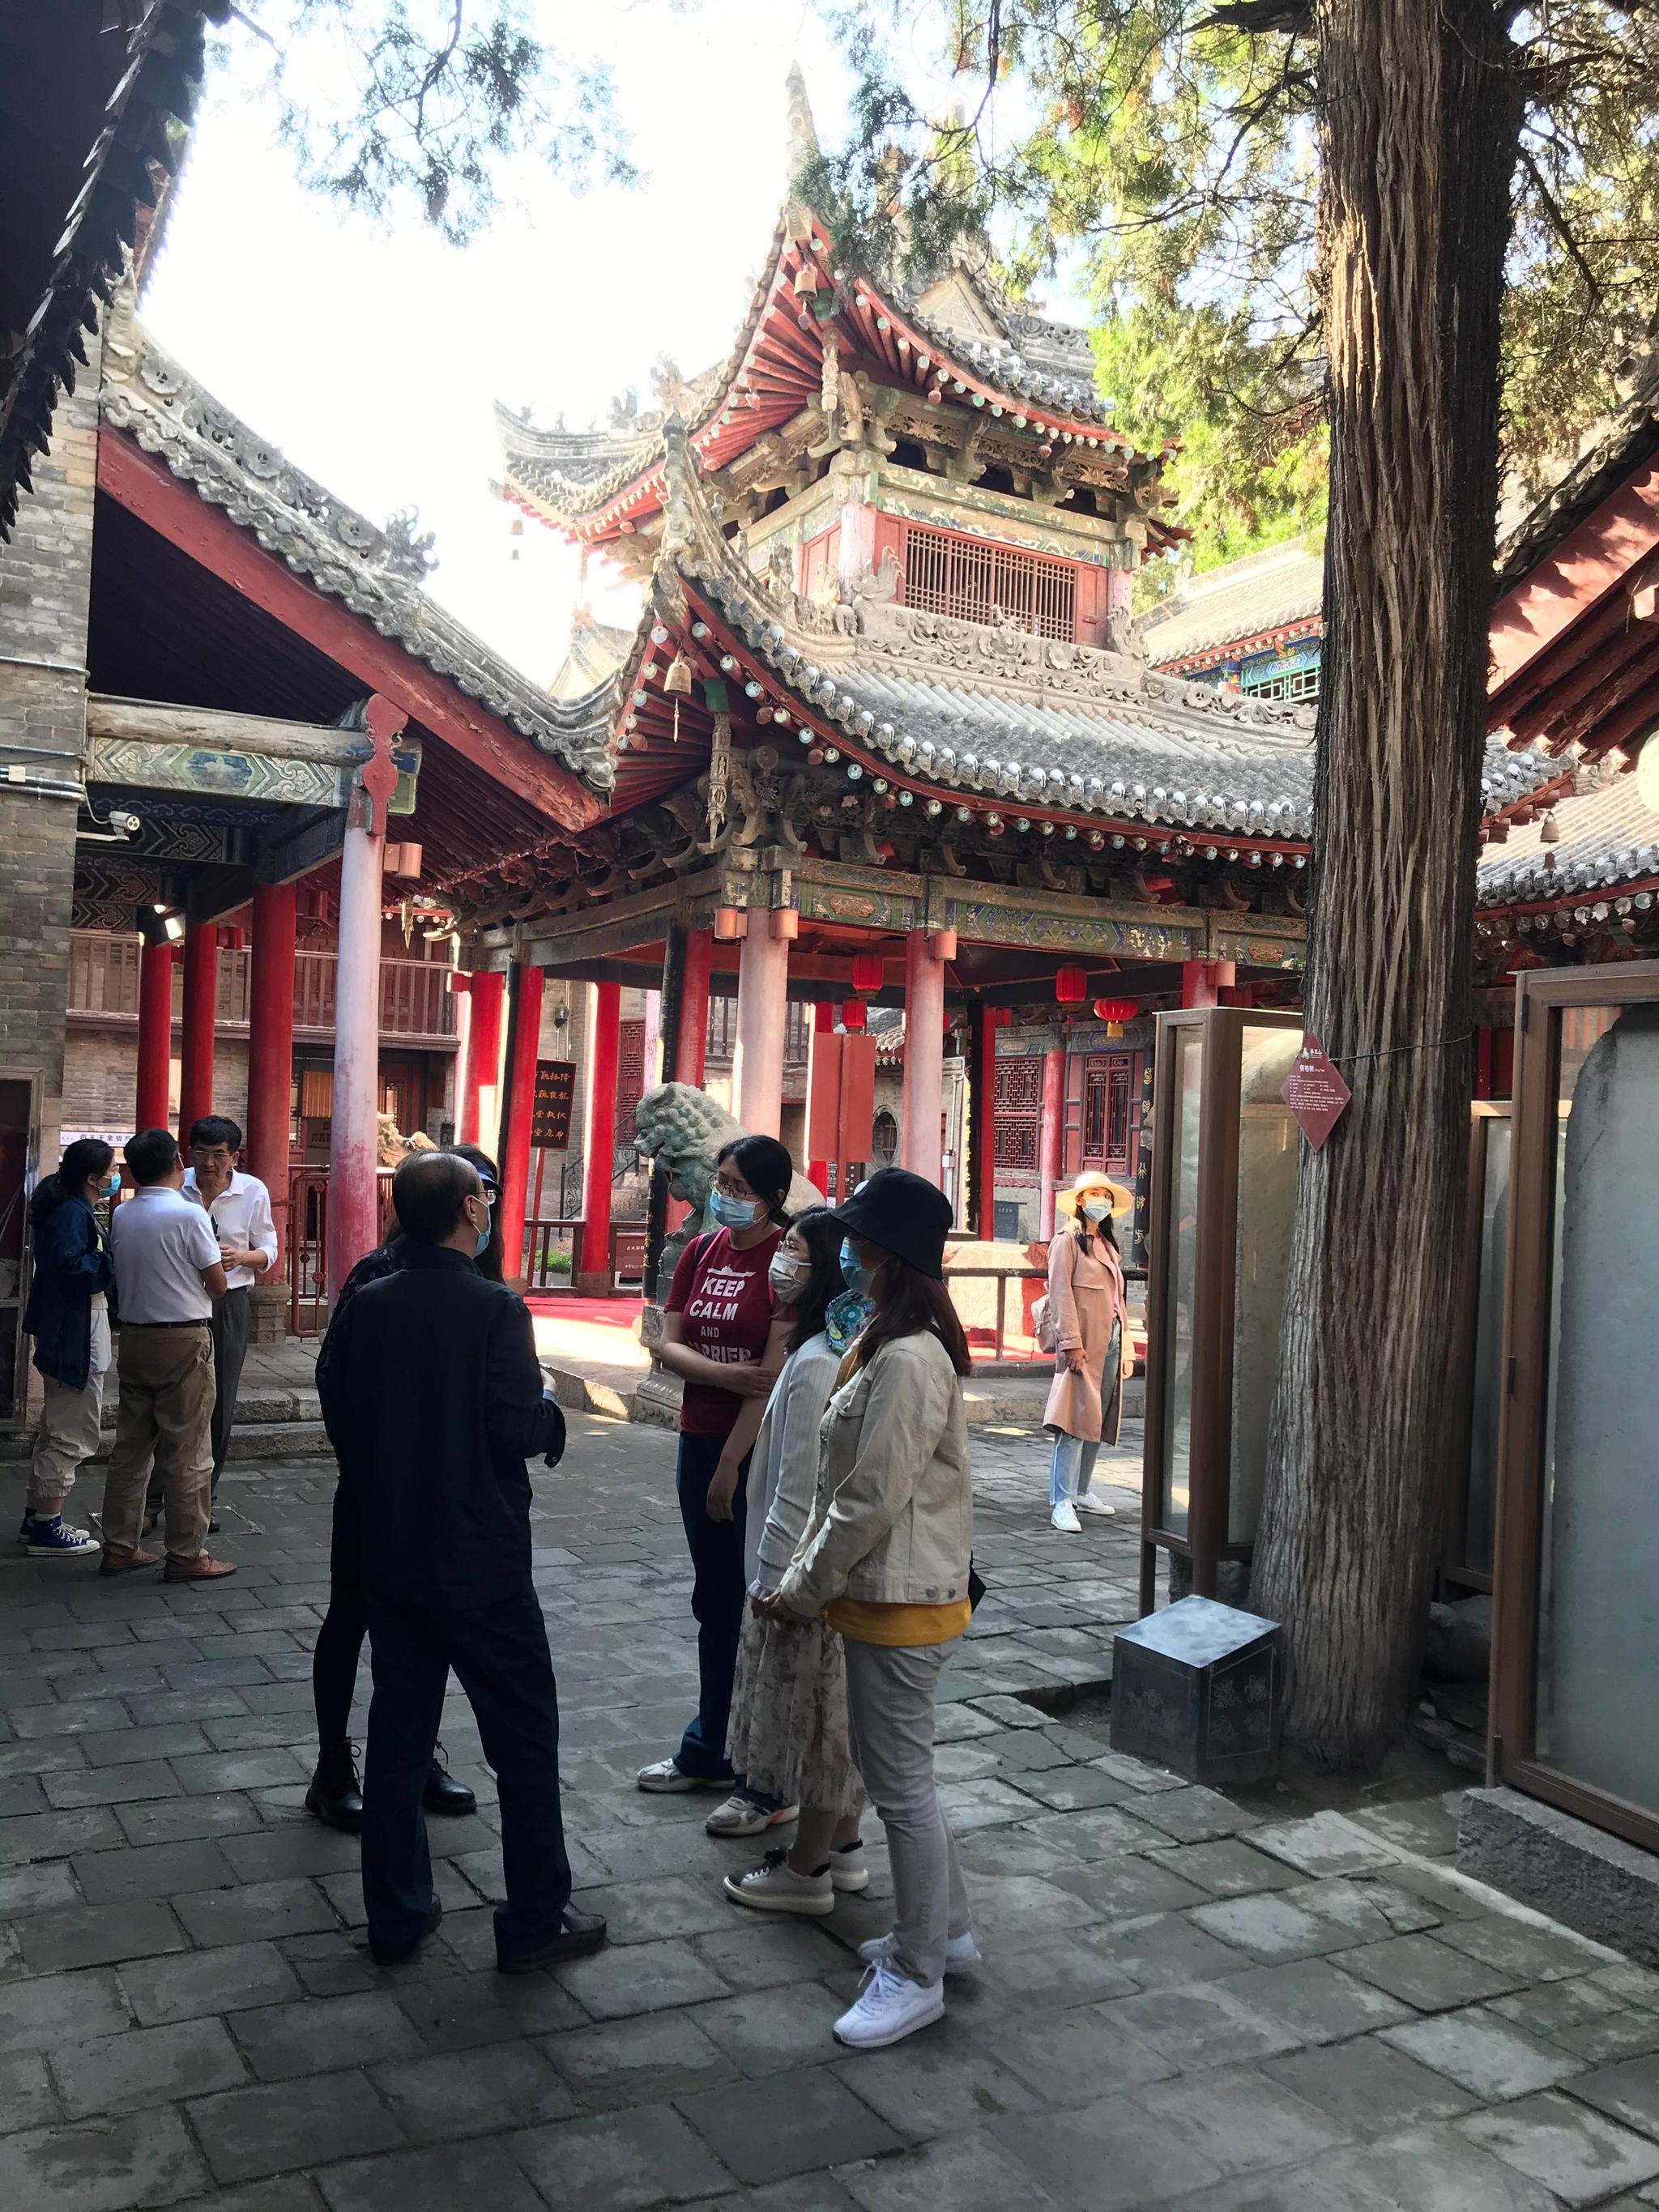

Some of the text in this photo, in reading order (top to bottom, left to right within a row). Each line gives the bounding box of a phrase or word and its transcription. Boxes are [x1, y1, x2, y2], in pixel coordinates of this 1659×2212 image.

[701, 1276, 745, 1297] KEEP
[689, 1299, 739, 1320] CALM
[701, 1326, 719, 1338] AND
[688, 1340, 751, 1363] RRIER
